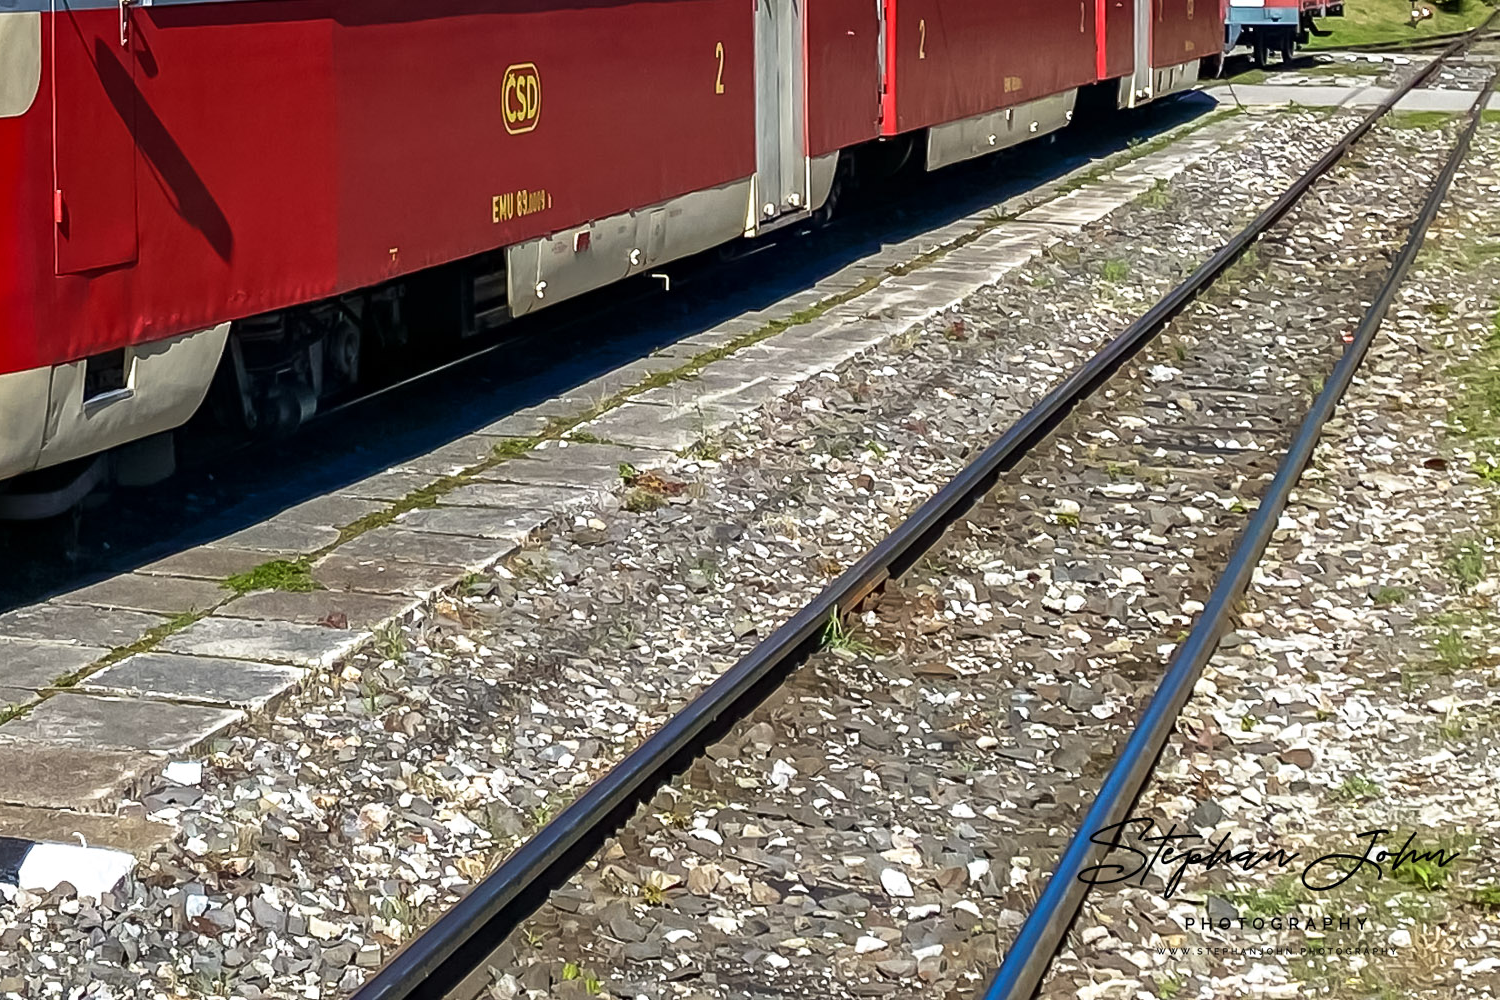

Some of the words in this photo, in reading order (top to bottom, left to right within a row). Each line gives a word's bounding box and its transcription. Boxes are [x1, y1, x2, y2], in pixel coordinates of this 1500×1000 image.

[918, 18, 927, 60] 2
[714, 41, 726, 95] 2
[504, 72, 539, 124] ČSD
[492, 191, 514, 224] EMU
